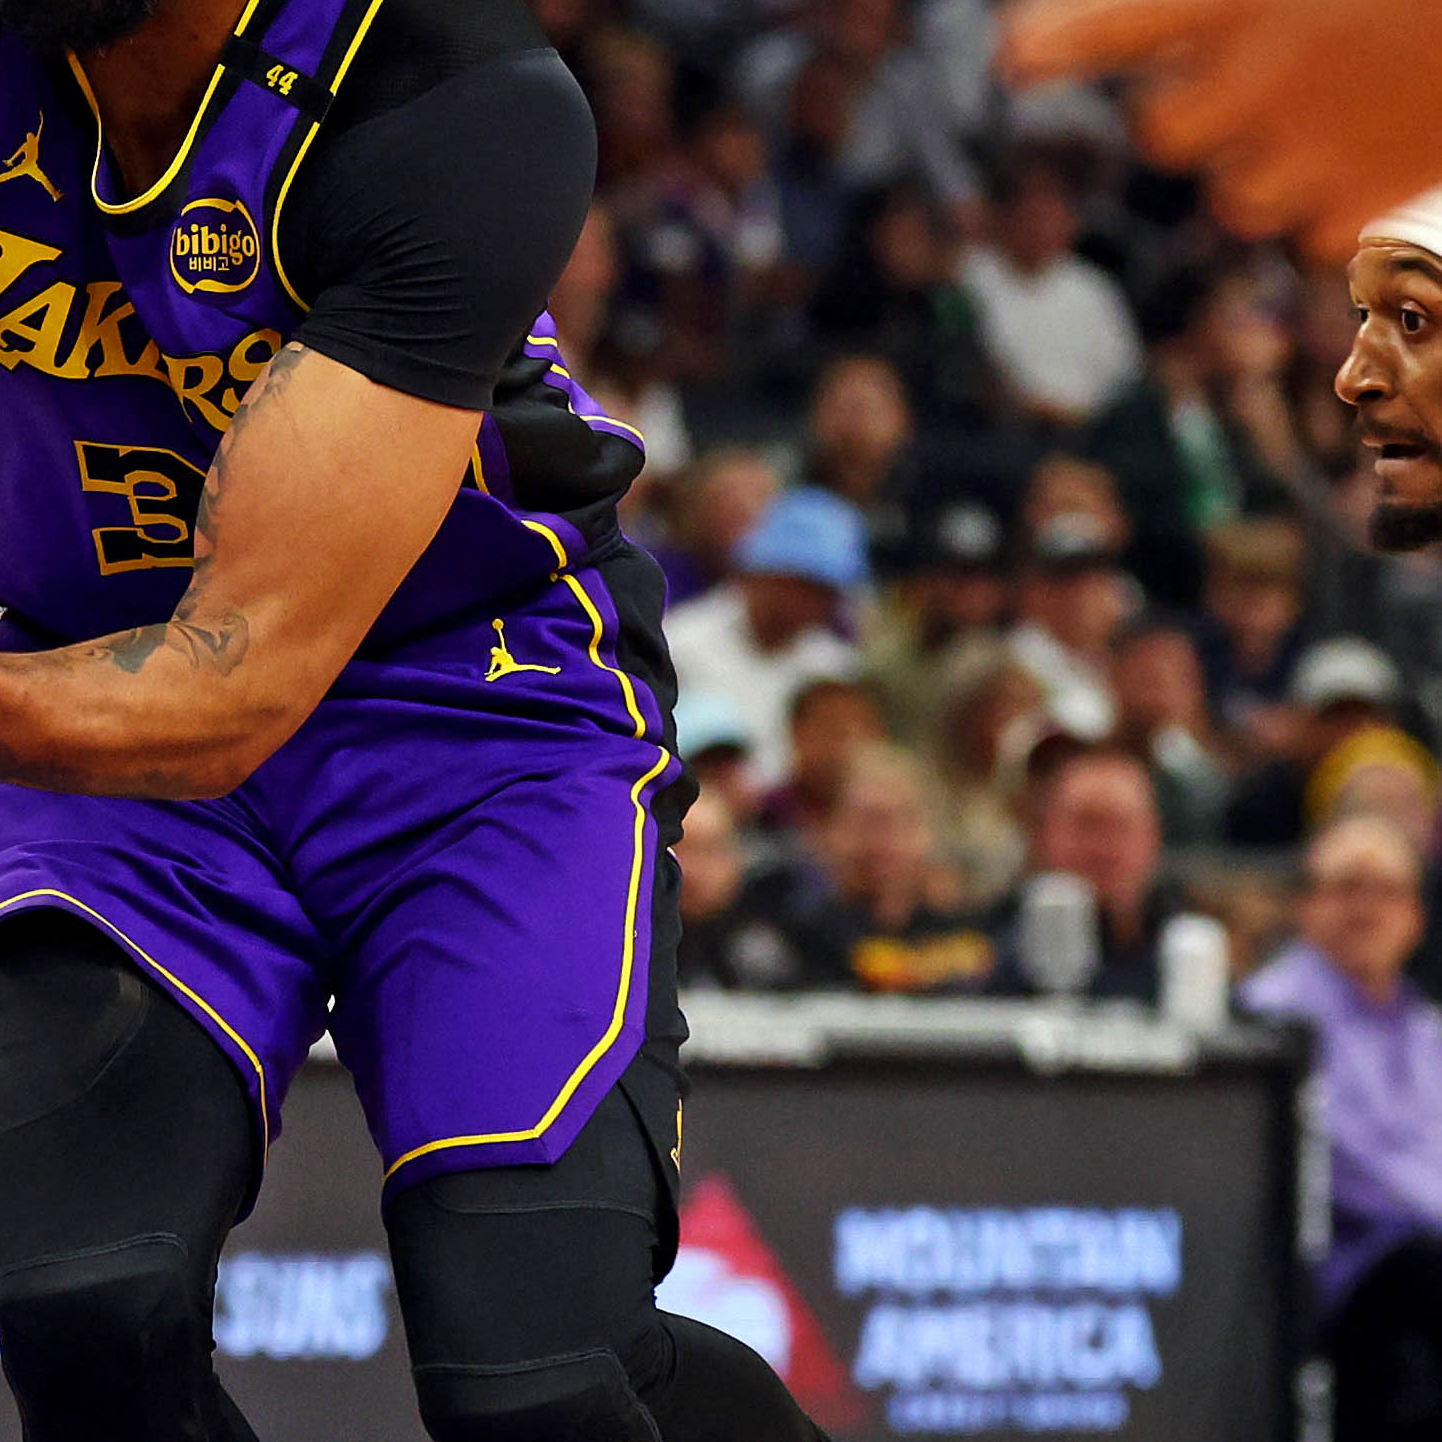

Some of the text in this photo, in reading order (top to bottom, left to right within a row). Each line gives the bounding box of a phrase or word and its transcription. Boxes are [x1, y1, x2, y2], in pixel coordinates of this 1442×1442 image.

[265, 64, 299, 96] 44
[175, 223, 256, 266] bibigo
[188, 257, 231, 272] 비비고
[73, 439, 208, 576] 3
